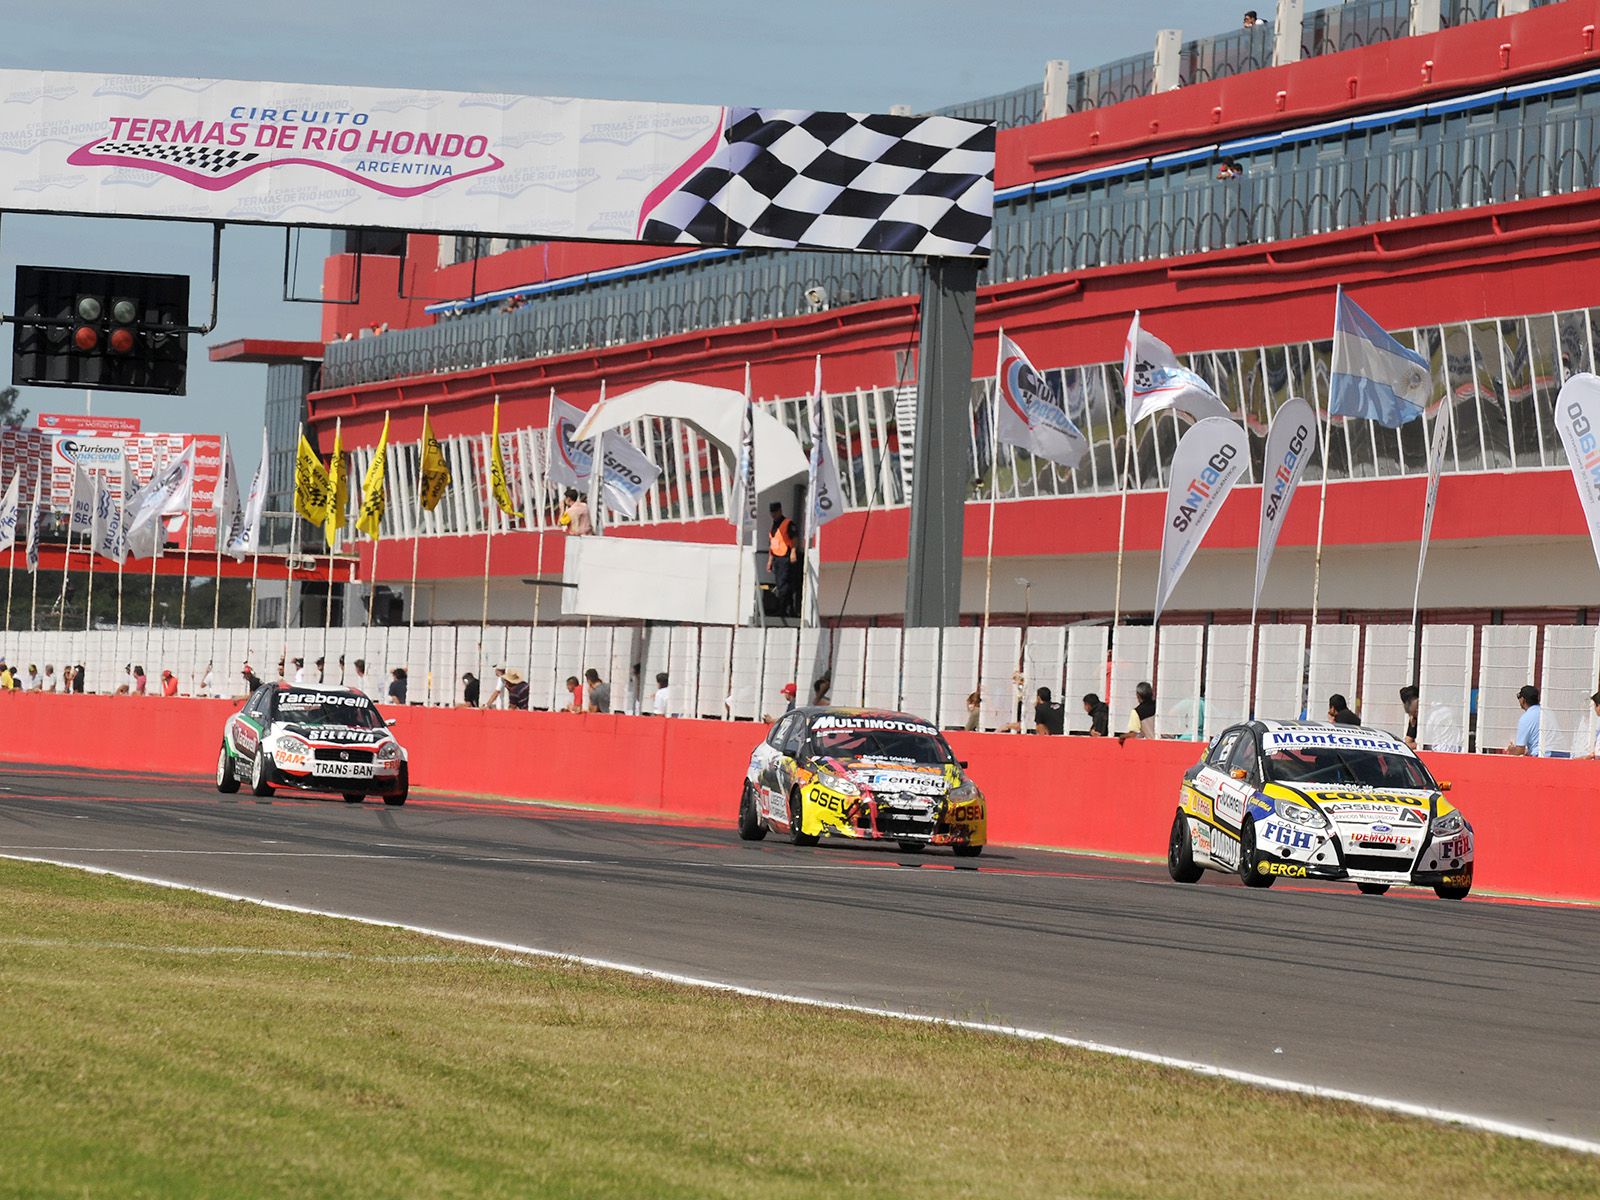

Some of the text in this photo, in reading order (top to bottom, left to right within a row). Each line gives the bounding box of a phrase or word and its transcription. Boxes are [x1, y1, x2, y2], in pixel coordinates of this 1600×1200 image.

[230, 106, 368, 126] CIRCUITO
[109, 116, 248, 146] TERMAS
[254, 124, 299, 149] DE
[366, 129, 488, 159] HONDO
[355, 160, 452, 176] ARGENTINA
[598, 210, 635, 221] TERMA
[79, 444, 120, 454] Turismo
[278, 691, 369, 709] Taraborelli
[811, 715, 939, 736] MULTIMOTORS
[1273, 732, 1402, 751] Montemar
[275, 750, 306, 765] FRAM
[888, 776, 946, 789] enfield
[1316, 792, 1423, 806] COIRO
[1331, 803, 1400, 813] ARSEMET
[1262, 822, 1314, 849] FGH
[1441, 835, 1471, 859] FGH
[1269, 861, 1308, 878] ERCA
